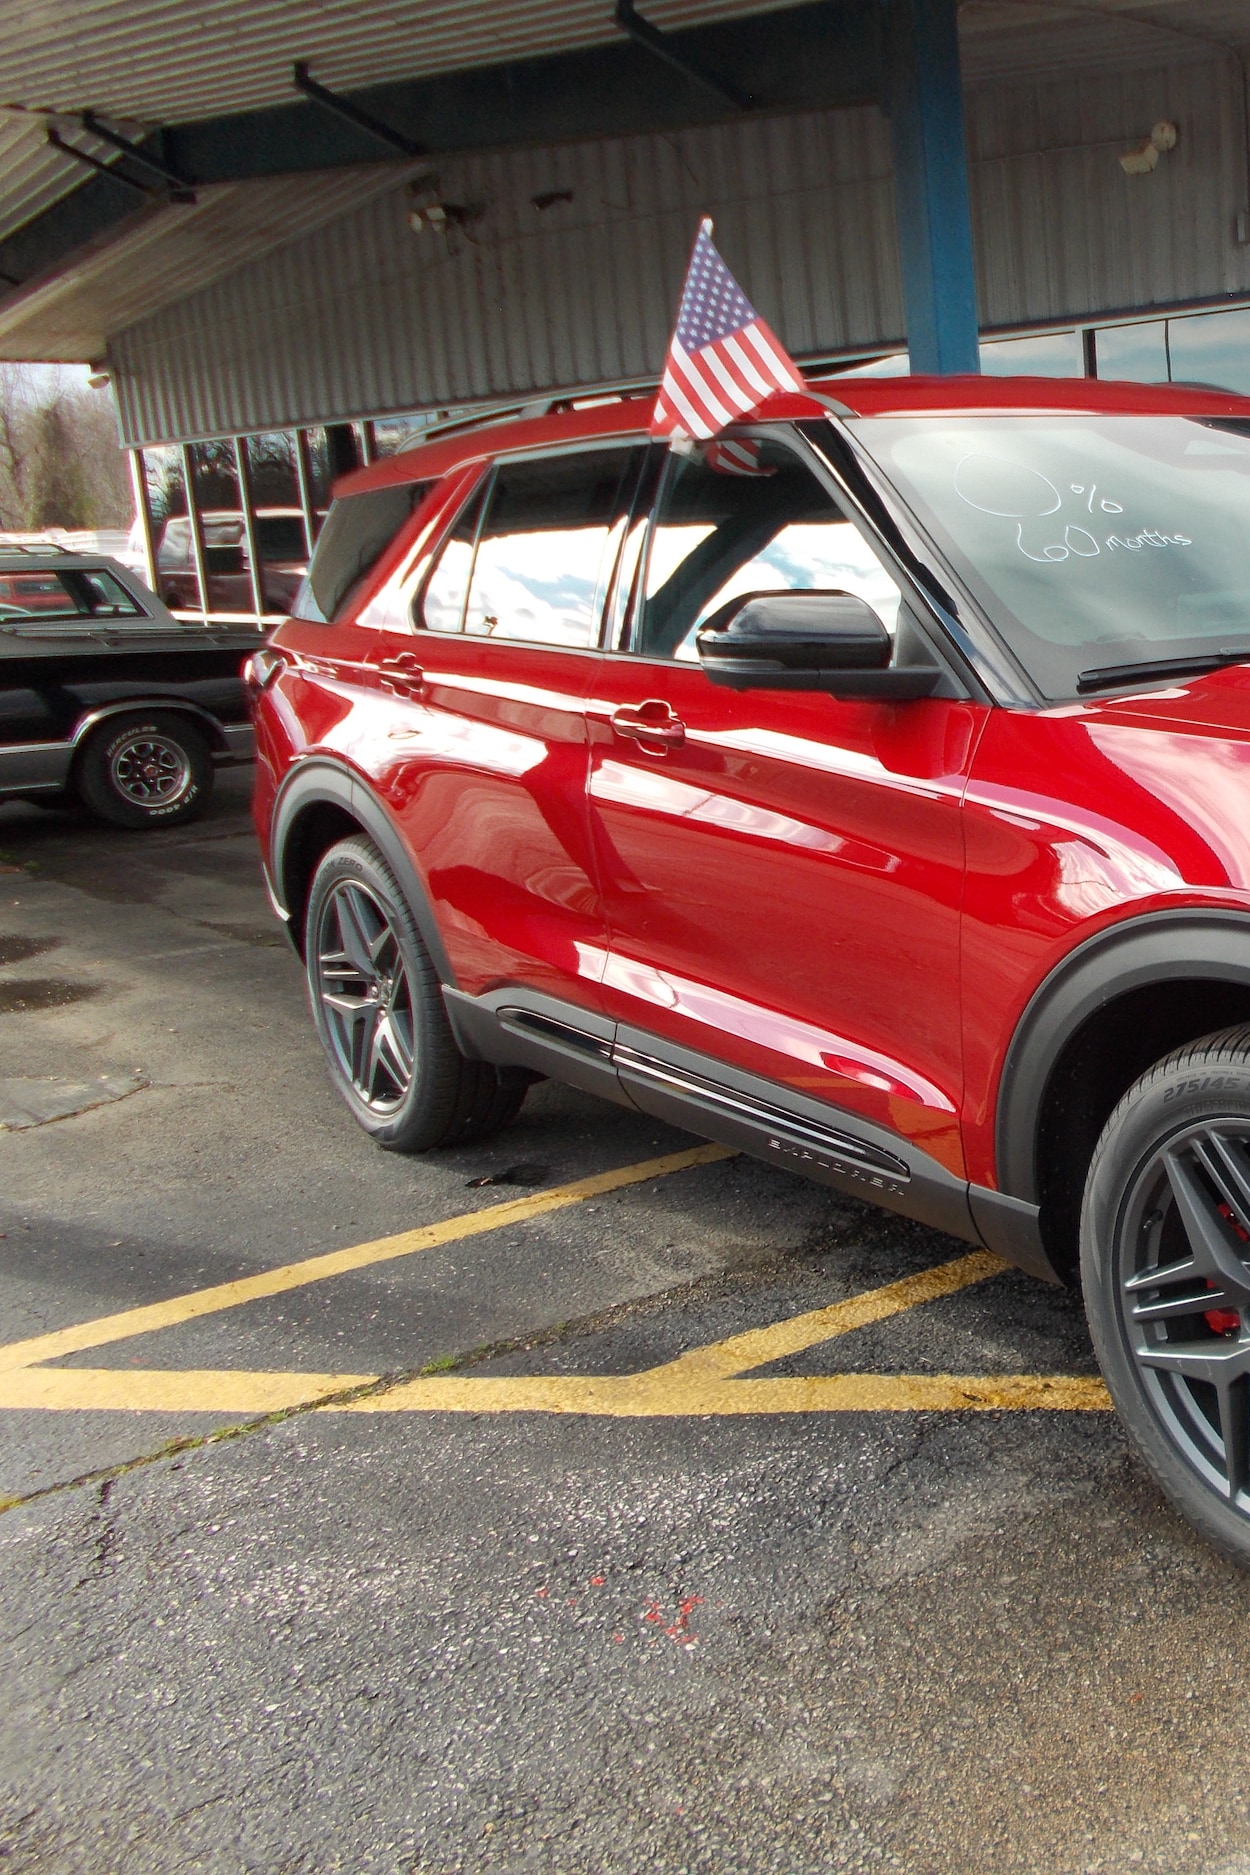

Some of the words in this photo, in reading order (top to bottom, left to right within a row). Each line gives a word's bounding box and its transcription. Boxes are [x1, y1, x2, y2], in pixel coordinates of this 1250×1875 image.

[1017, 523, 1100, 562] 60
[337, 857, 363, 872] ZERO
[1163, 1076, 1241, 1103] 275/45
